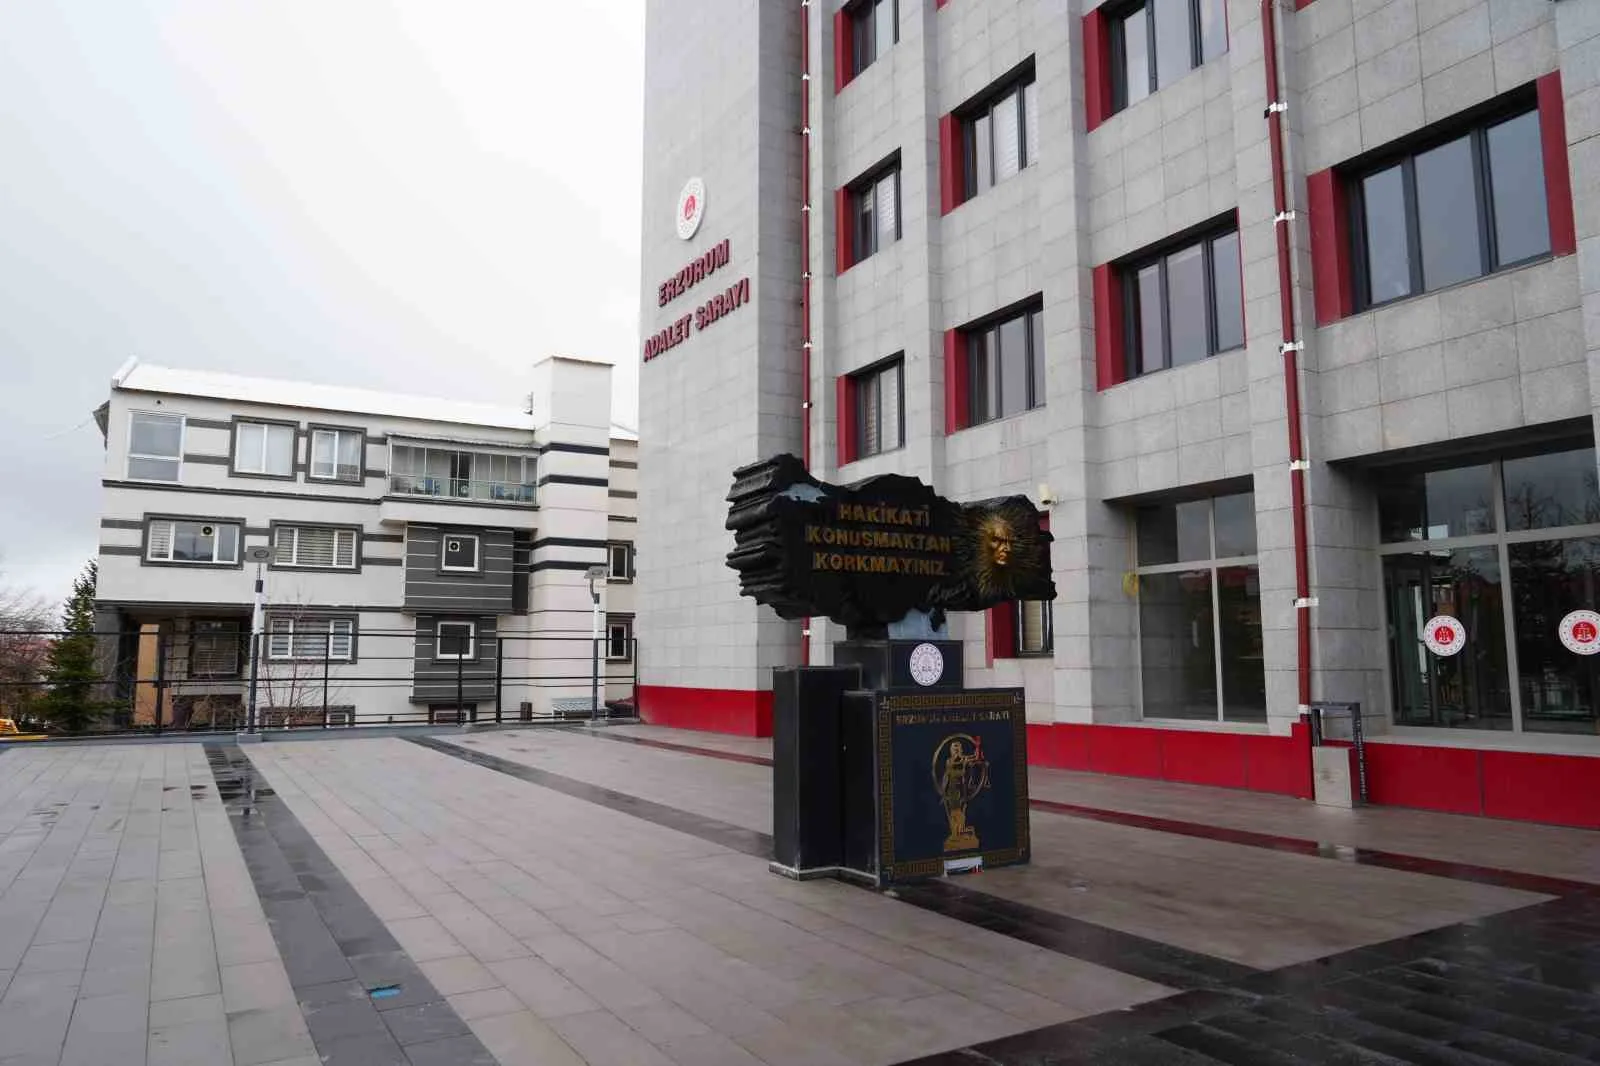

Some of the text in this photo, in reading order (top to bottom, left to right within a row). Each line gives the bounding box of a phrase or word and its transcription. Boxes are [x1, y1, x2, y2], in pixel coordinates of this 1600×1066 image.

[658, 238, 730, 307] ERZURUM
[643, 277, 750, 362] ADALET SARAYI
